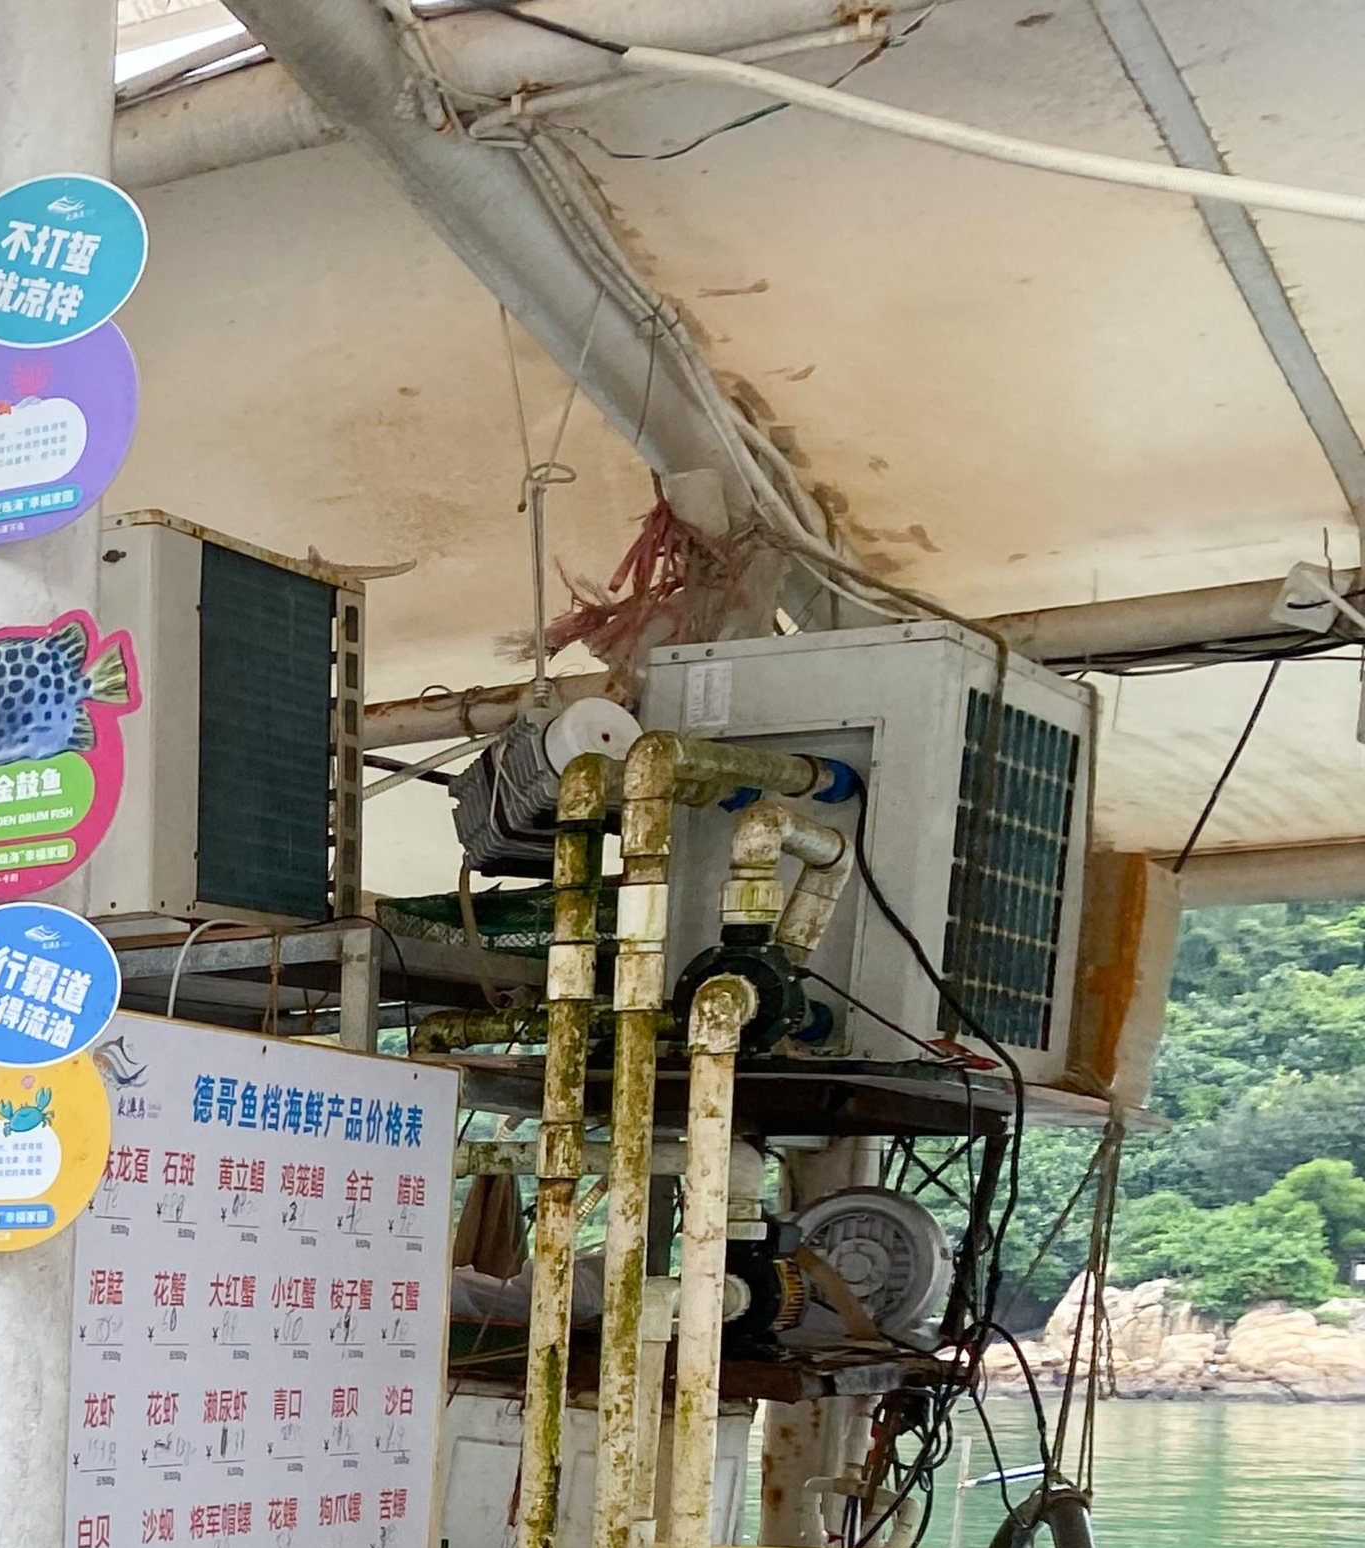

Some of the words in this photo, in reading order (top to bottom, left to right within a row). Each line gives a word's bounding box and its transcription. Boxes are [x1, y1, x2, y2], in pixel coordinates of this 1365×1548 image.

[1, 219, 102, 276] 不打蜇
[18, 810, 49, 827] DRUM
[50, 805, 75, 823] FISH
[192, 1074, 424, 1149] 德哥鱼档海鲜产品价格表
[162, 1151, 197, 1185] 石斑
[346, 1170, 373, 1204] 金古
[153, 1272, 186, 1307] 花蟹
[210, 1276, 256, 1309] 大红蟹
[272, 1278, 316, 1310] 小红蟹
[392, 1280, 419, 1312] 石蟹
[84, 1392, 114, 1427] 龙虾
[145, 1391, 180, 1425] 花虾
[273, 1388, 304, 1420] 青口
[384, 1385, 414, 1415] 沙白
[189, 1502, 252, 1537] 将军帽螺
